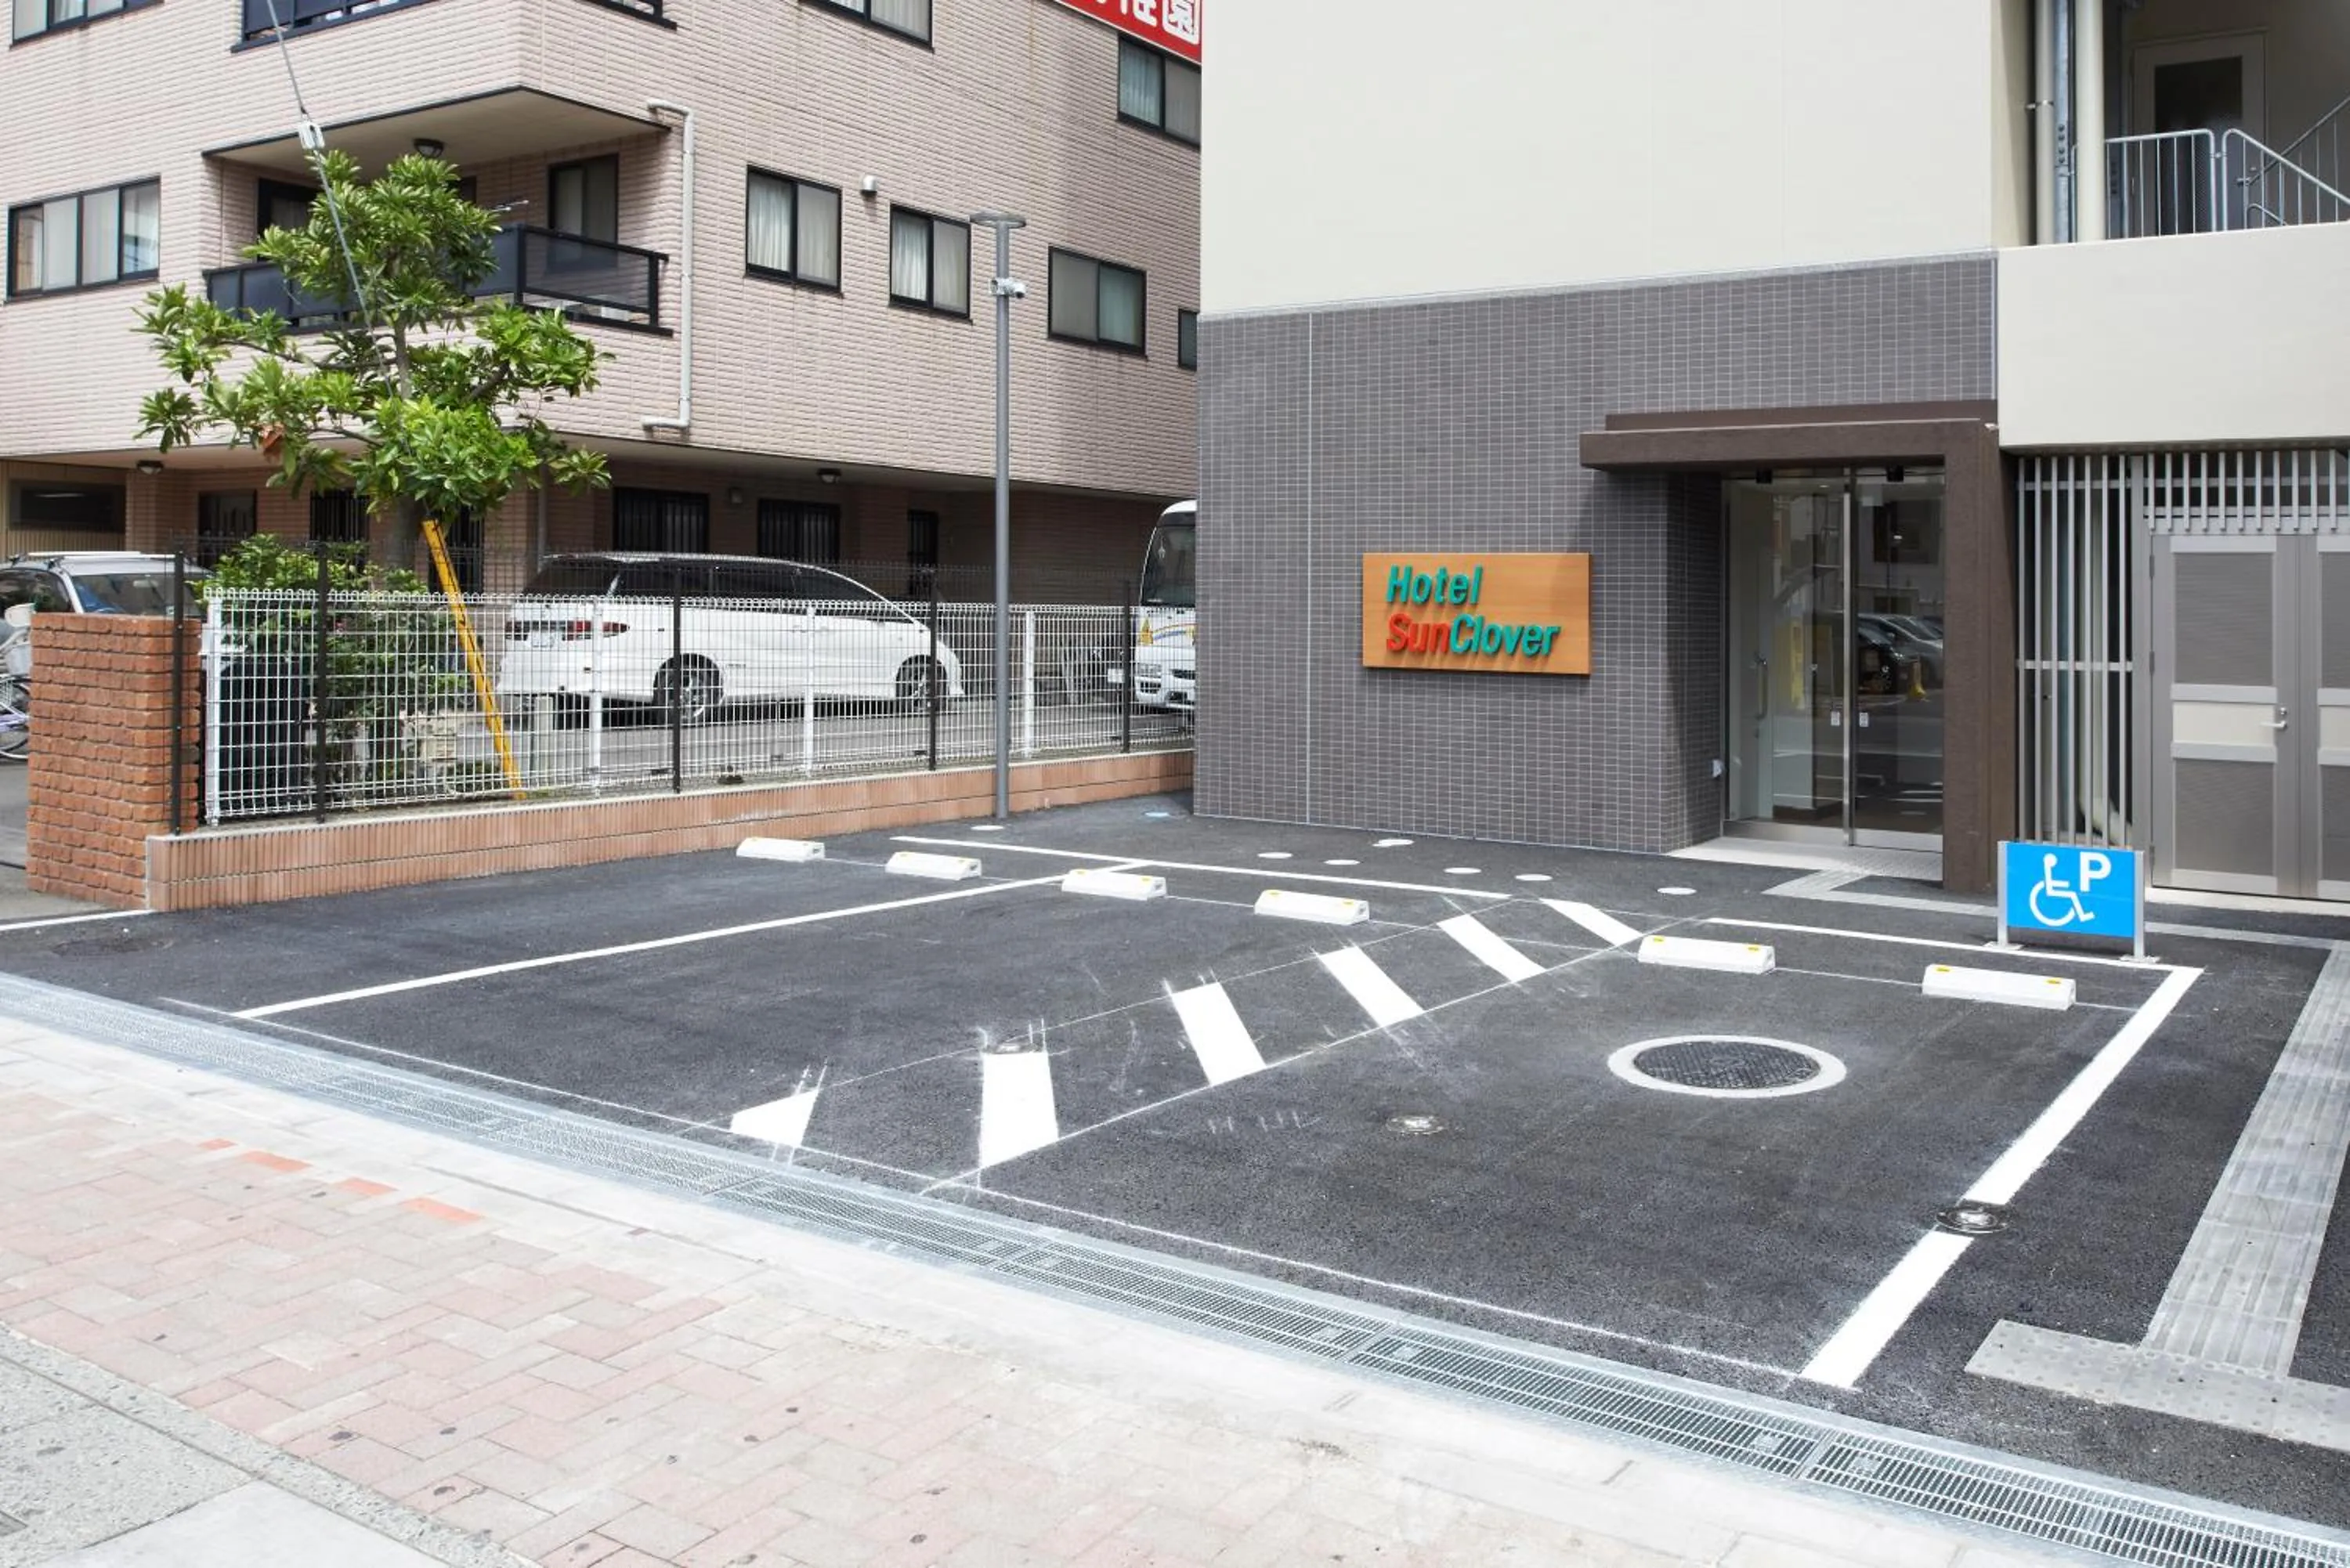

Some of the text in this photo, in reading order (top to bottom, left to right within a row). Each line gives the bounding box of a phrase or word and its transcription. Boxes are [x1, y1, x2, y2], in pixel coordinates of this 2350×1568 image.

[1120, 0, 1200, 44] 園
[1386, 564, 1484, 605] Hotel
[1386, 612, 1562, 657] SunClover
[2080, 851, 2112, 893] P
